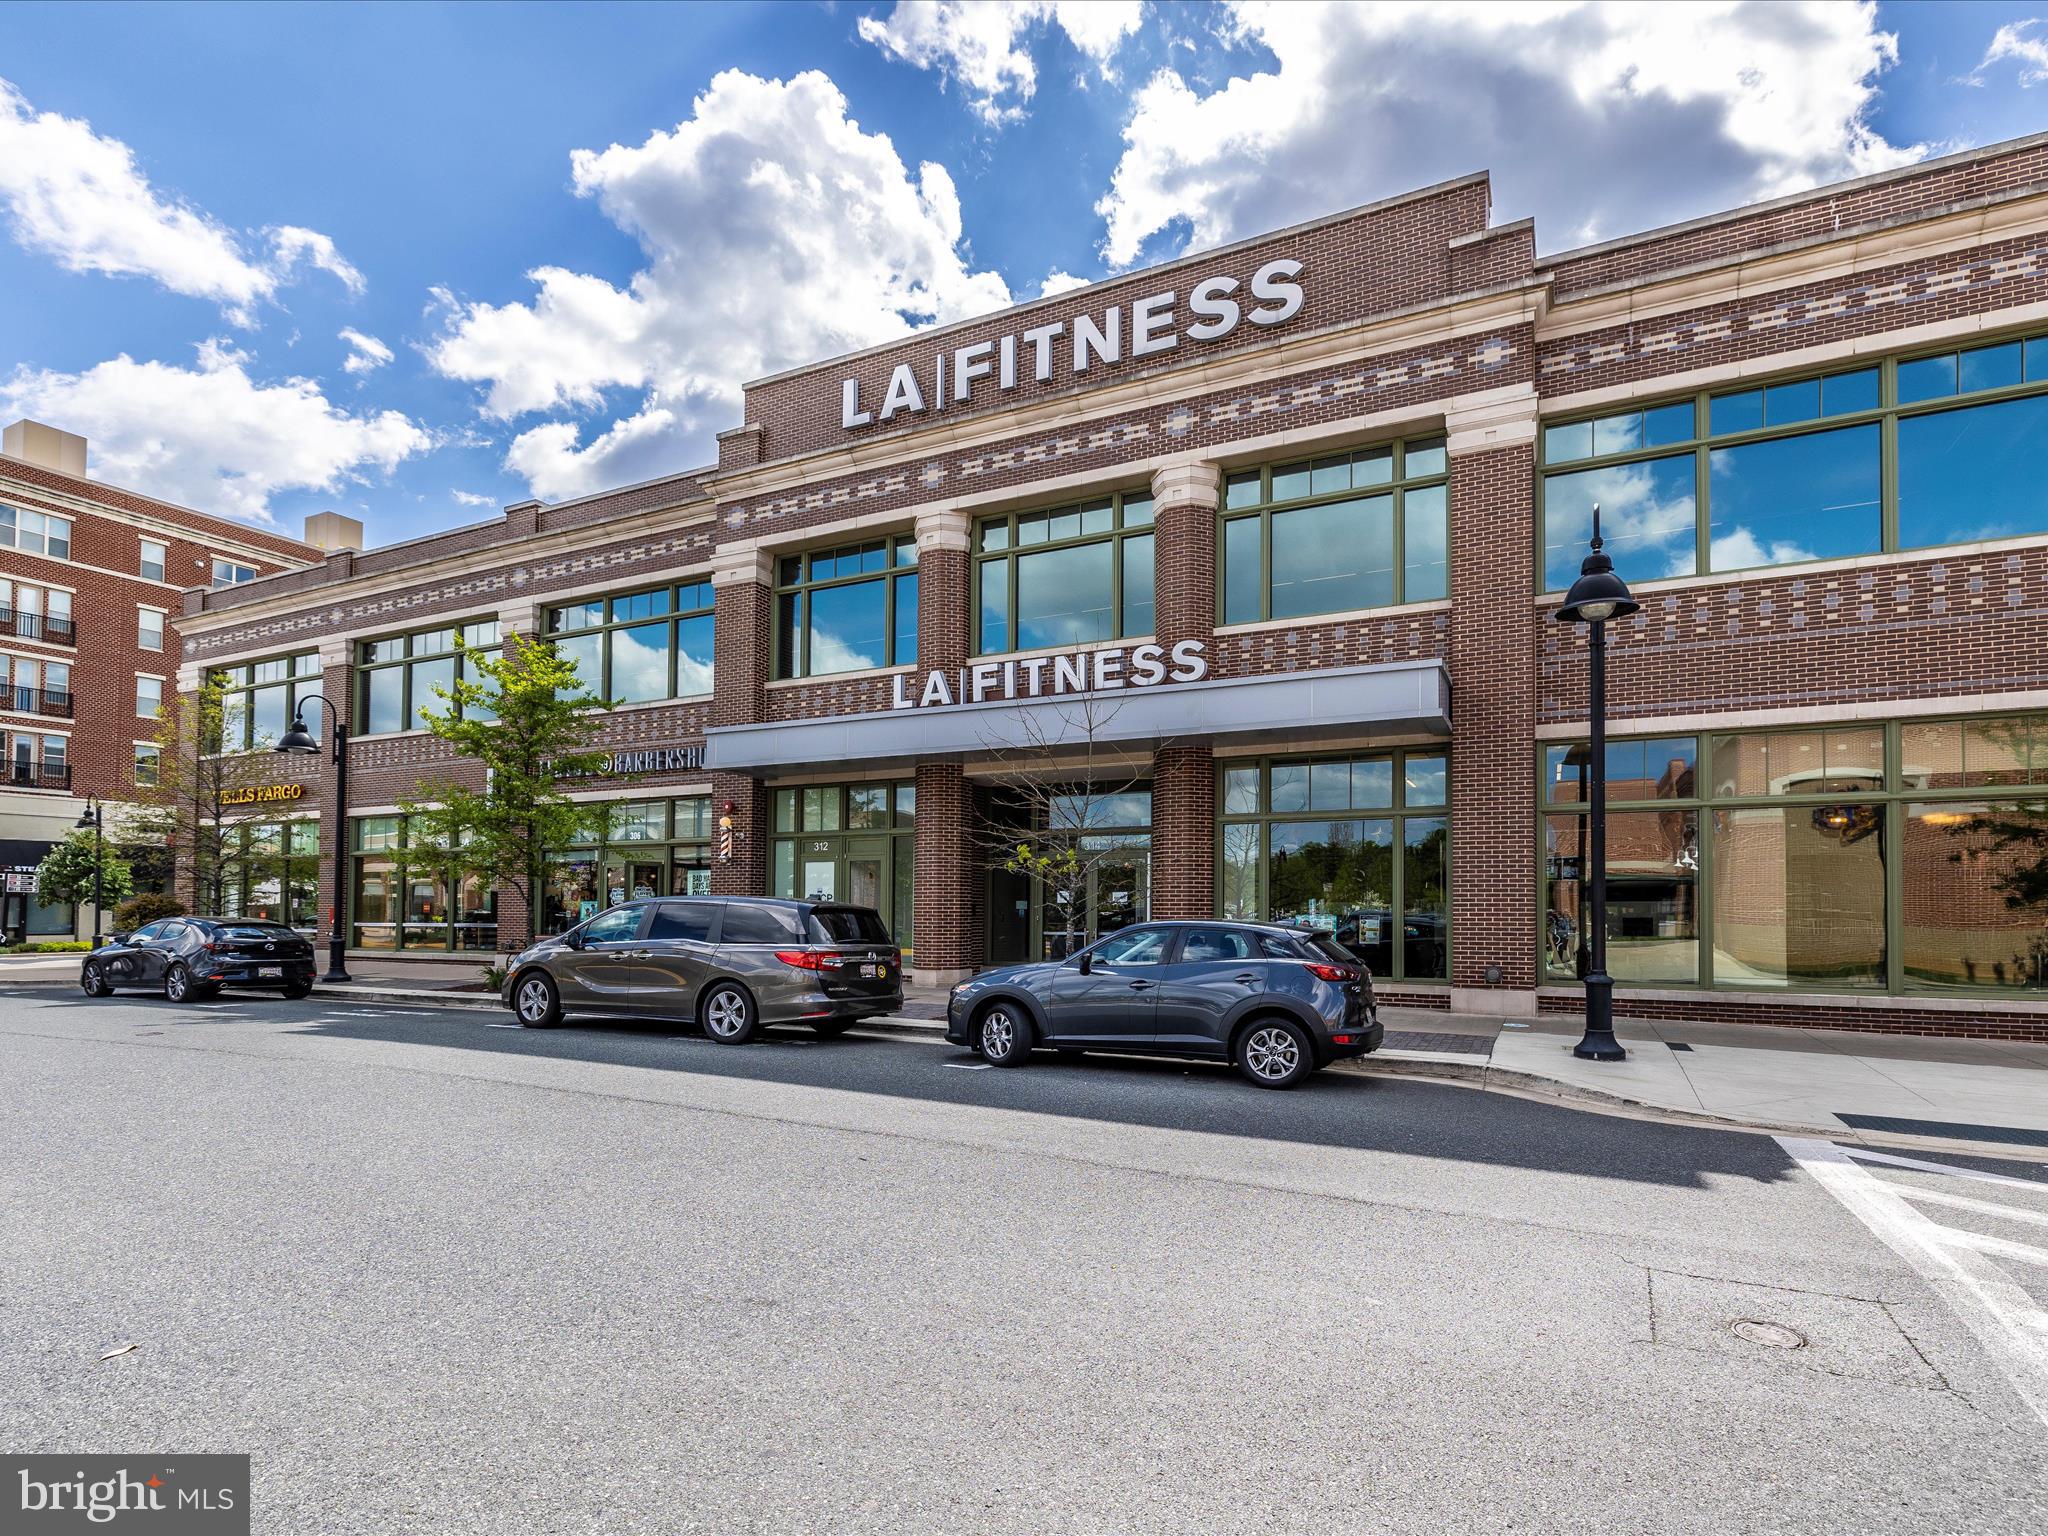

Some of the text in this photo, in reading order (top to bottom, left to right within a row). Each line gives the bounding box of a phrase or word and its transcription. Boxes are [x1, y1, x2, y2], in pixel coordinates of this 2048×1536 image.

[954, 259, 1306, 403] FITNESS
[972, 640, 1209, 703] FITNESS
[211, 784, 301, 805] ELLS FARGO
[812, 841, 829, 851] 312
